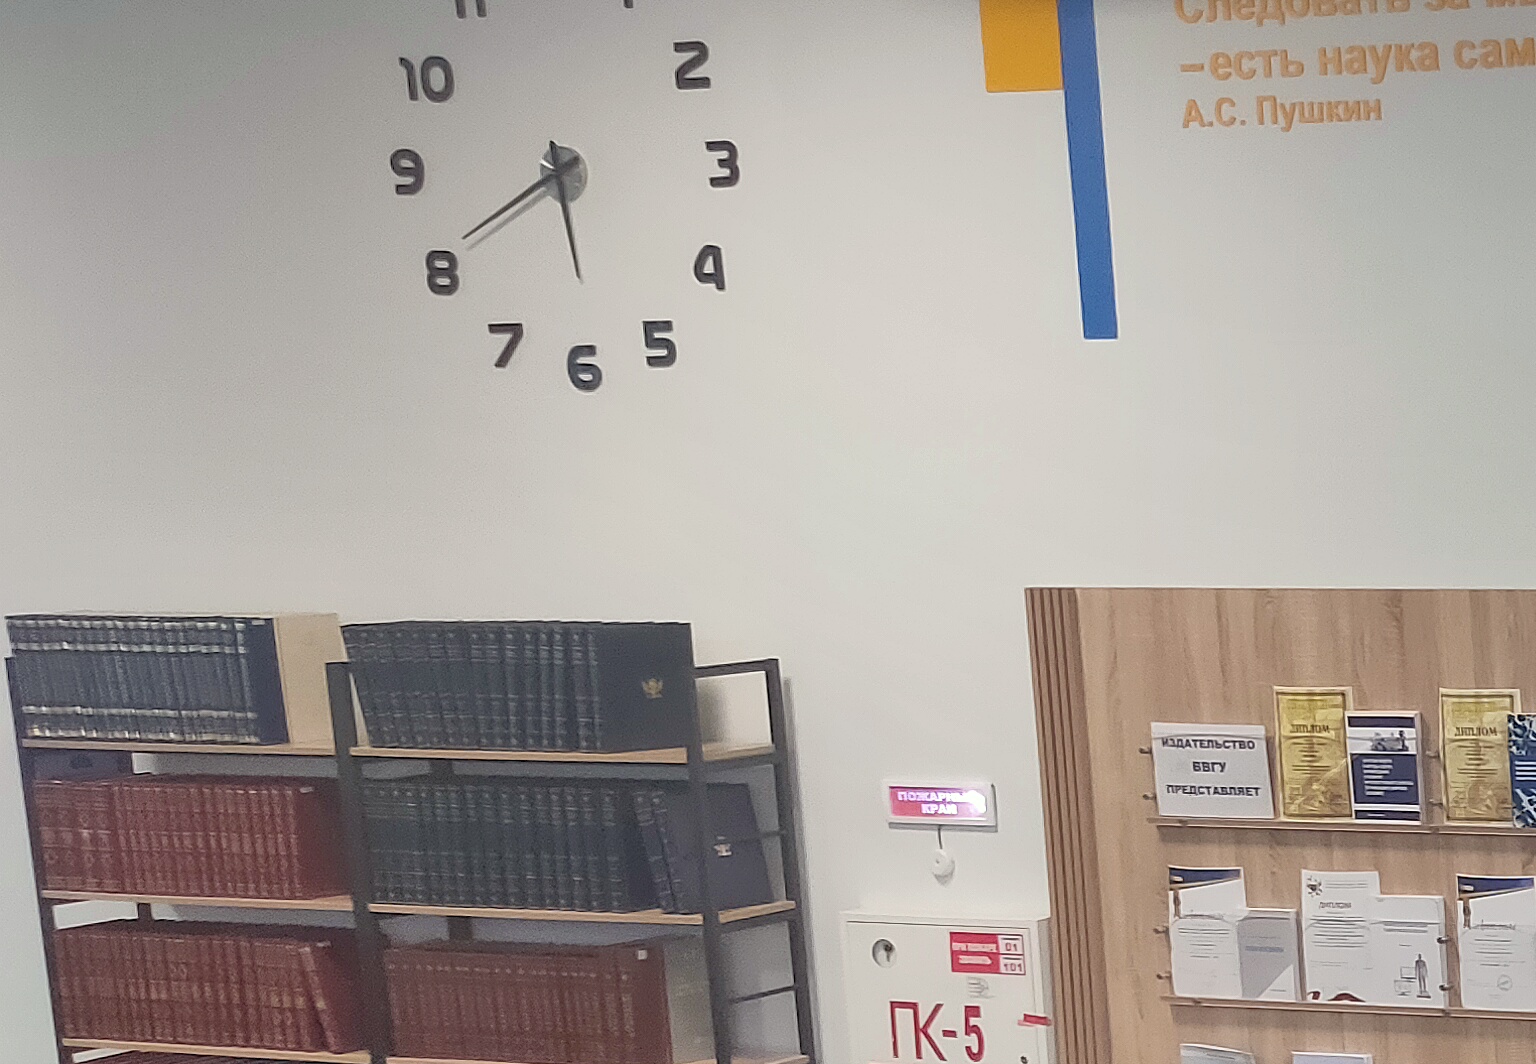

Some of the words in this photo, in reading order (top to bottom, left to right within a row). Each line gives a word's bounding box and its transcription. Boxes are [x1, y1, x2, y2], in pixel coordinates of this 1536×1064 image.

[399, 56, 454, 103] 10
[673, 41, 711, 90] 2
[1318, 44, 1441, 84] наука
[1182, 97, 1246, 129] А.С.
[1256, 94, 1382, 132] Пушкин
[390, 149, 425, 196] 9
[705, 140, 740, 188] 3
[426, 250, 459, 295] 8
[694, 245, 725, 291] 4
[488, 323, 523, 368] 7
[643, 320, 677, 368] 5
[567, 345, 602, 392] 6
[1162, 738, 1255, 750] ИЗДАТЕЛЬСТВО
[897, 791, 978, 803] ПОЖАРН
[1166, 784, 1261, 797] ПРЕДСТАВЛЯЕТ
[889, 1000, 986, 1063] ПК-5
